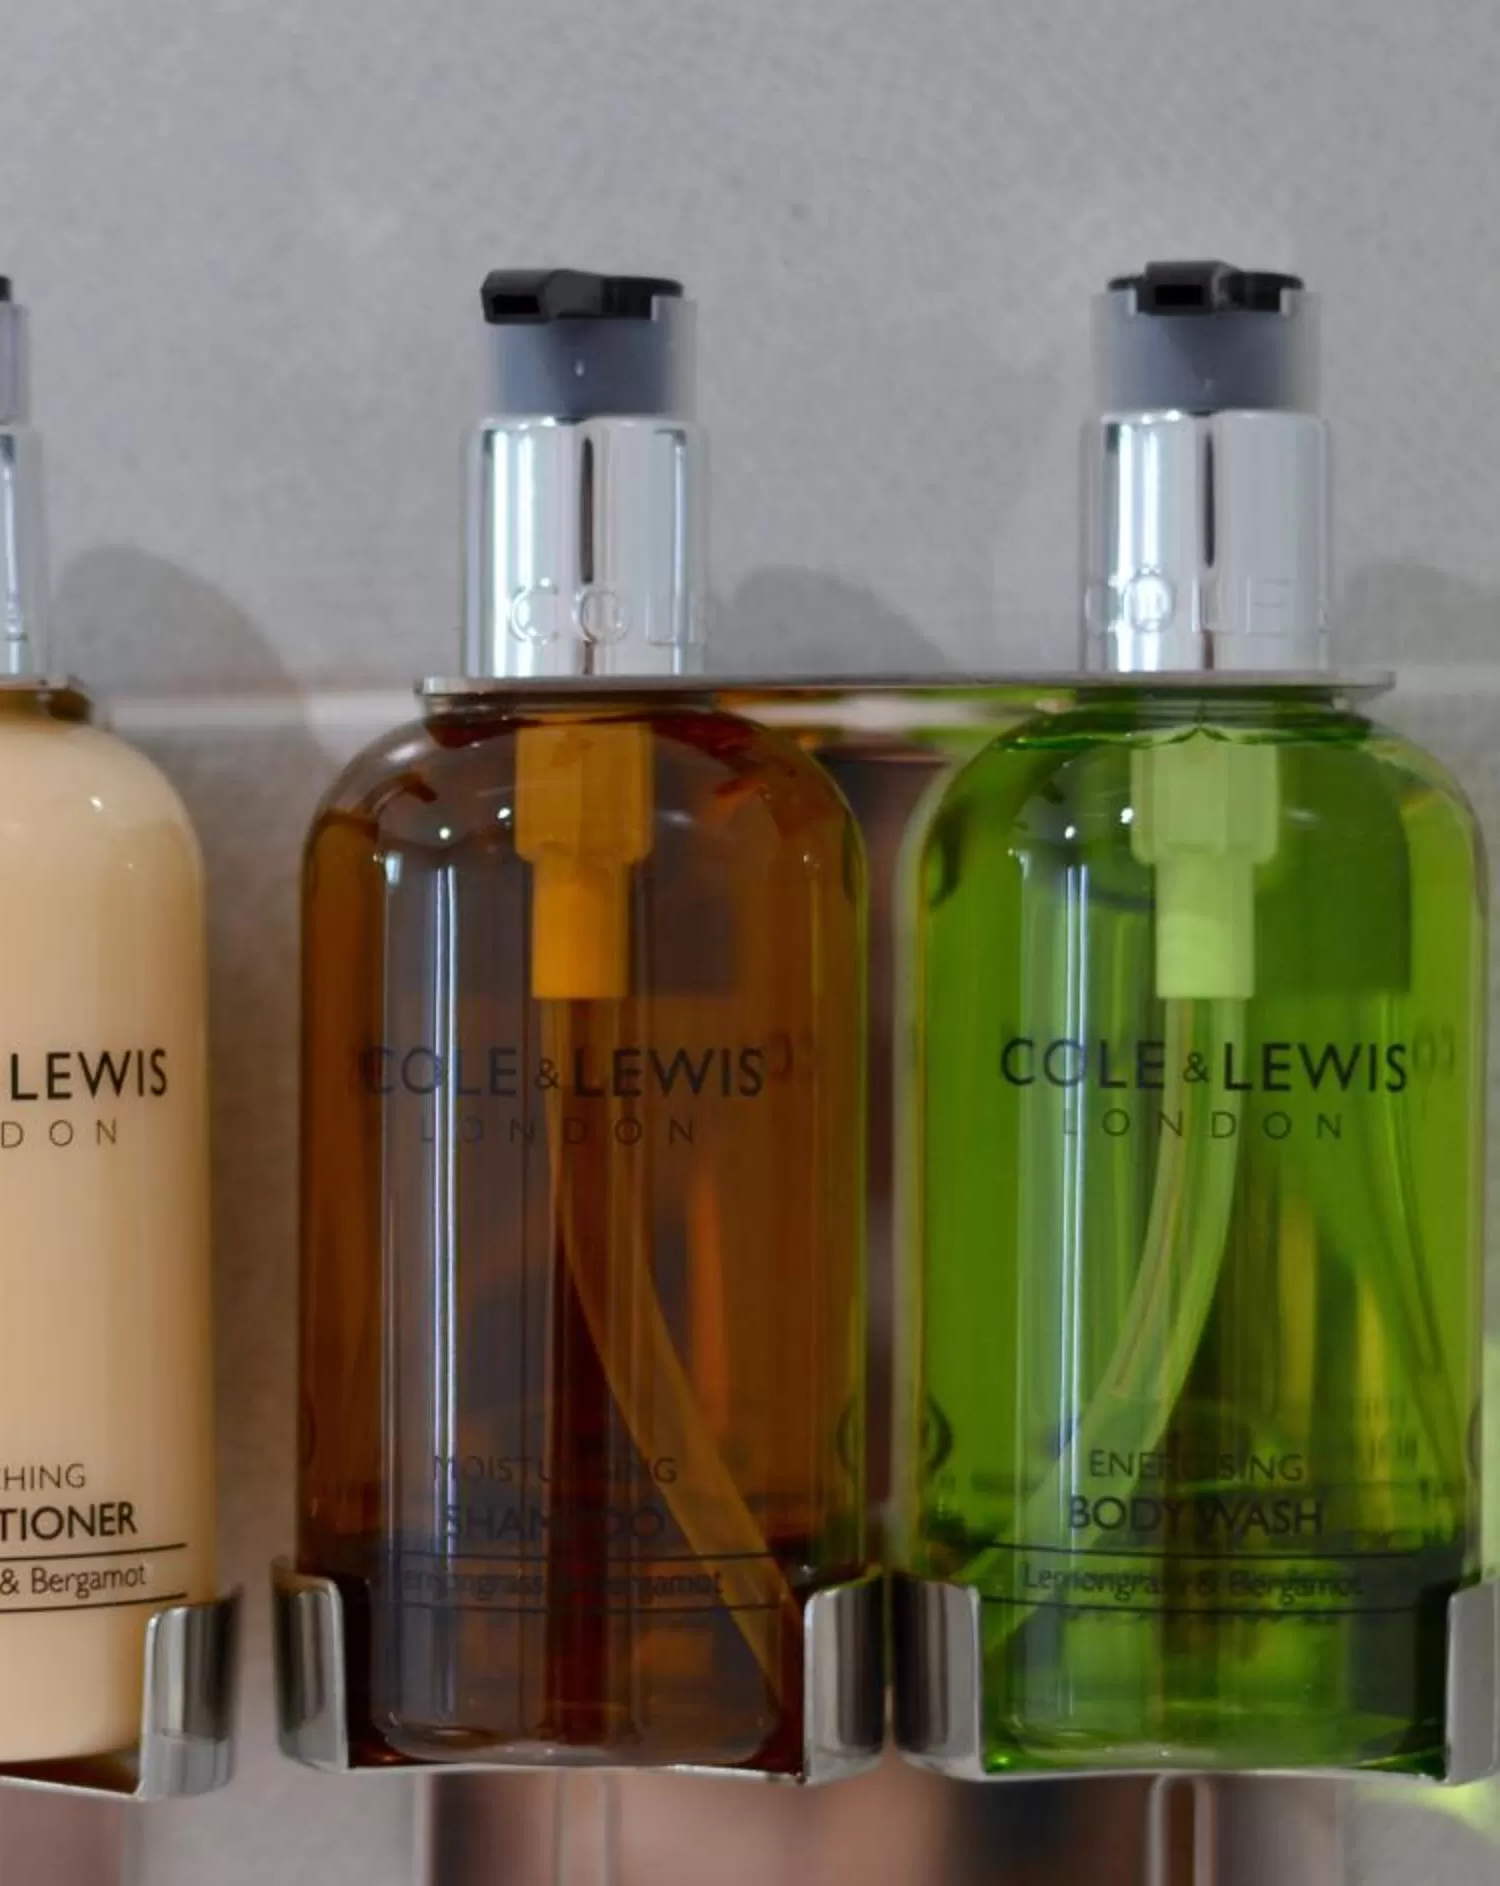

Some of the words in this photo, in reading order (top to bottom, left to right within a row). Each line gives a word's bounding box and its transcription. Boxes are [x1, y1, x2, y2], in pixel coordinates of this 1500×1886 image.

[10, 1048, 169, 1101] LEWIS
[364, 1045, 518, 1098] COLE
[535, 1056, 561, 1092] &
[574, 1046, 766, 1098] LEWIS
[1000, 1037, 1167, 1091] COLE
[1182, 1050, 1211, 1084] &
[1223, 1041, 1409, 1094] LEWIS
[421, 1115, 696, 1147] LONDON
[1063, 1107, 1344, 1140] LONDON
[1089, 1448, 1306, 1482] ENERSING
[442, 1504, 667, 1543] SHAMOO
[1067, 1494, 1184, 1534] BODY
[1192, 1497, 1324, 1537] WASH
[31, 1563, 148, 1600] Bergamot
